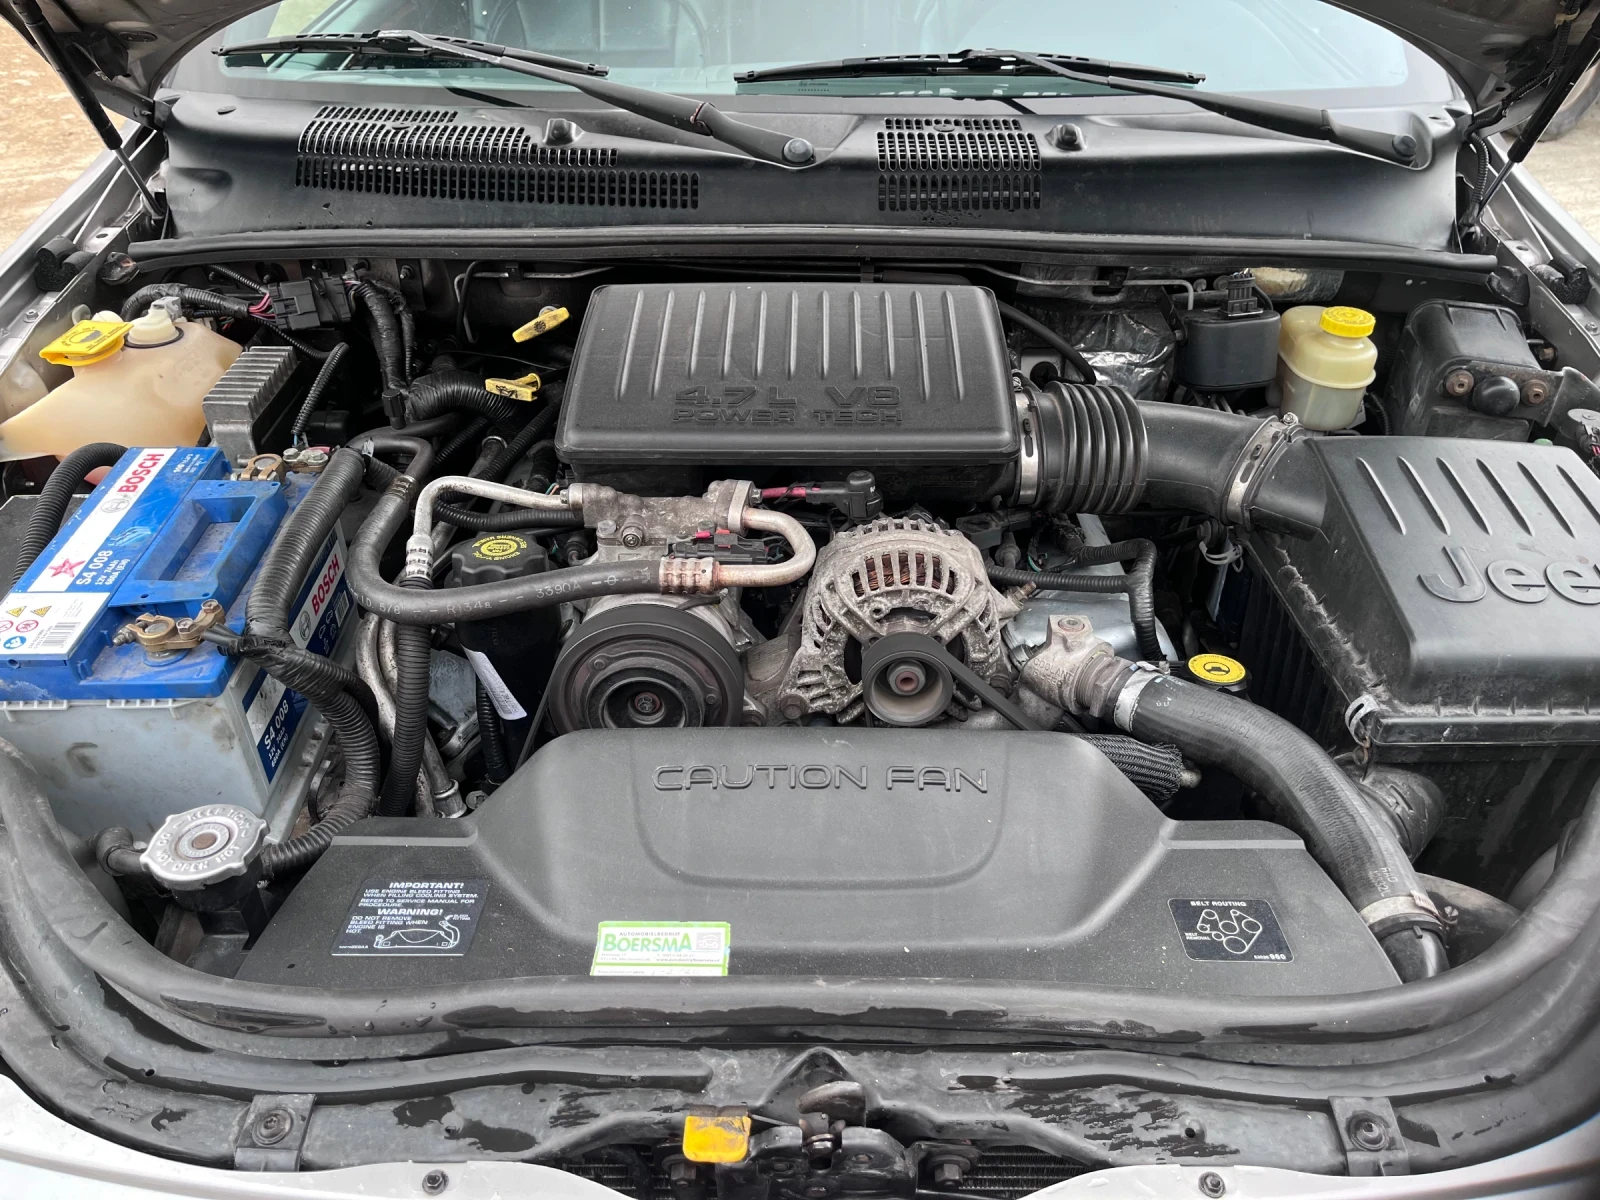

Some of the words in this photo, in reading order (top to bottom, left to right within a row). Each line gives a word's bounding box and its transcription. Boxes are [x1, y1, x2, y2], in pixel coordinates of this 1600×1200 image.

[824, 386, 901, 408] V8
[672, 408, 796, 423] POWER
[812, 408, 902, 423] TECH
[116, 452, 165, 494] BOSCH
[75, 571, 97, 585] S4
[88, 550, 113, 570] 008
[1416, 545, 1600, 606] Jee
[311, 553, 340, 616] BOSCH
[1033, 657, 1075, 681] COOLANT
[264, 725, 275, 750] S4
[275, 699, 289, 729] 008
[652, 764, 868, 790] CAUTION
[885, 765, 988, 794] FAN
[602, 932, 692, 952] BOERSMA
